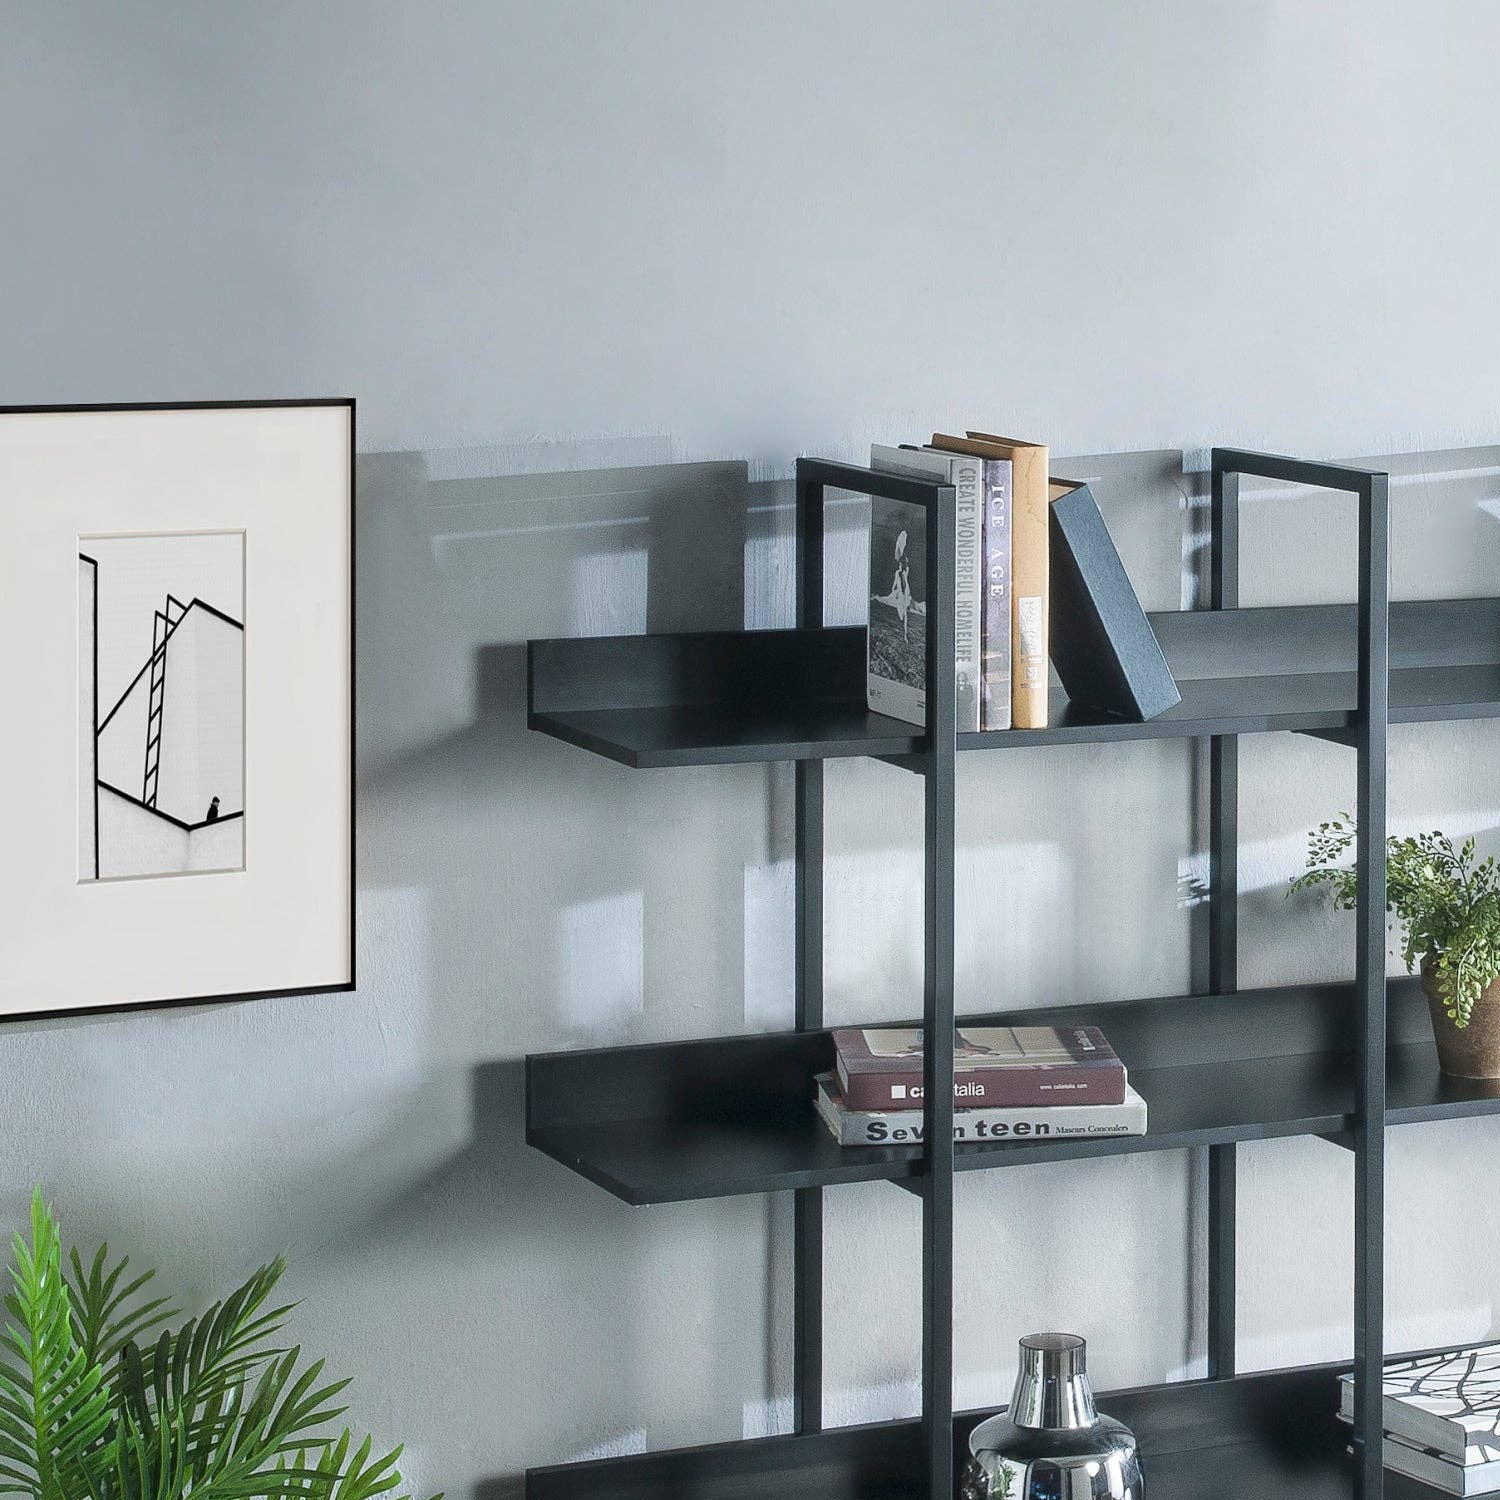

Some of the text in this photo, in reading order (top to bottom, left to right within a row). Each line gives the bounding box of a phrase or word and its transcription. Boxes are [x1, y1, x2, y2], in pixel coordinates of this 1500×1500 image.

[956, 467, 976, 662] CREATE WONDERFUL HOMELIFE
[990, 485, 1005, 597] ICE AGE
